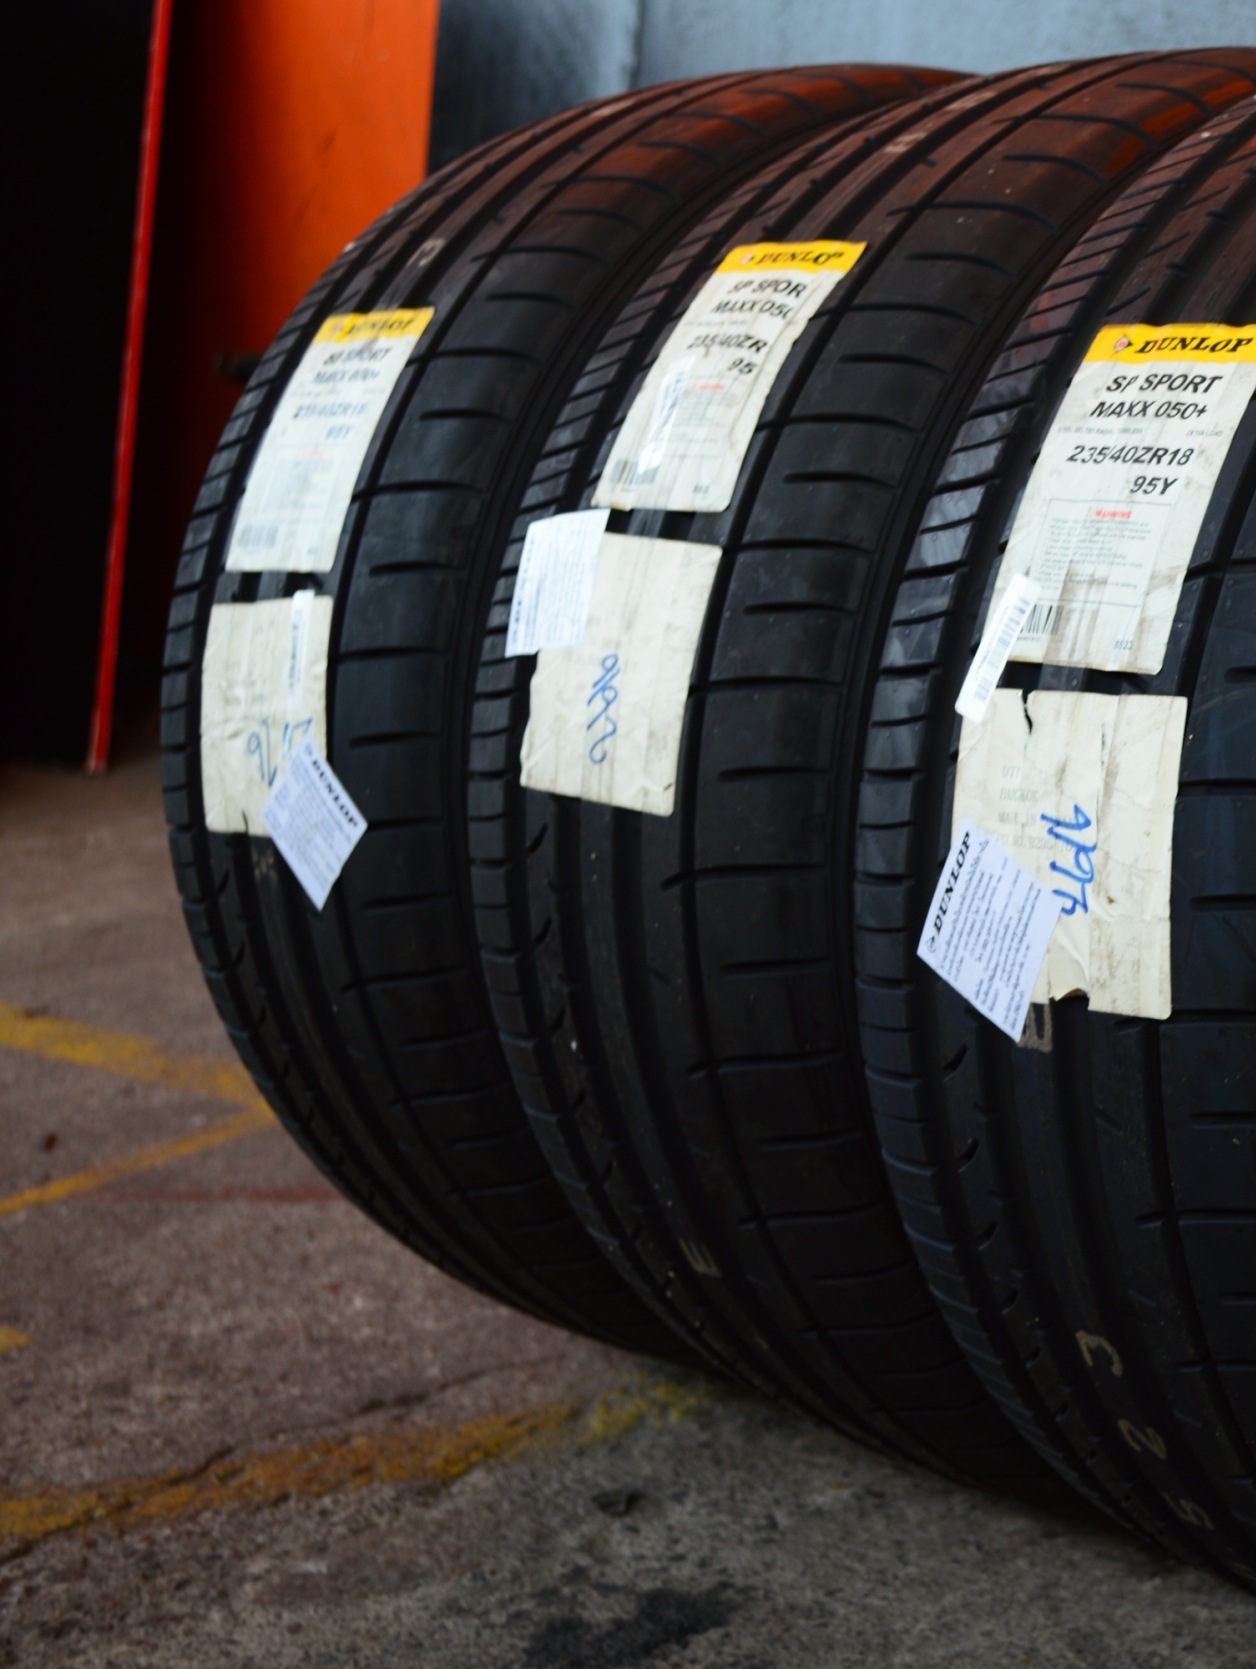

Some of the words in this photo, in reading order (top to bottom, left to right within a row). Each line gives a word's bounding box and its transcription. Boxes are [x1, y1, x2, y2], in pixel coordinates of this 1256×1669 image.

[711, 301, 758, 315] MAXX
[1135, 337, 1254, 355] DUNLOP
[1139, 373, 1224, 395] SPORT
[1090, 401, 1153, 419] MAXX
[1156, 402, 1209, 421] 050+
[1130, 476, 1180, 496] 95Y
[933, 831, 971, 936] DUNLOP
